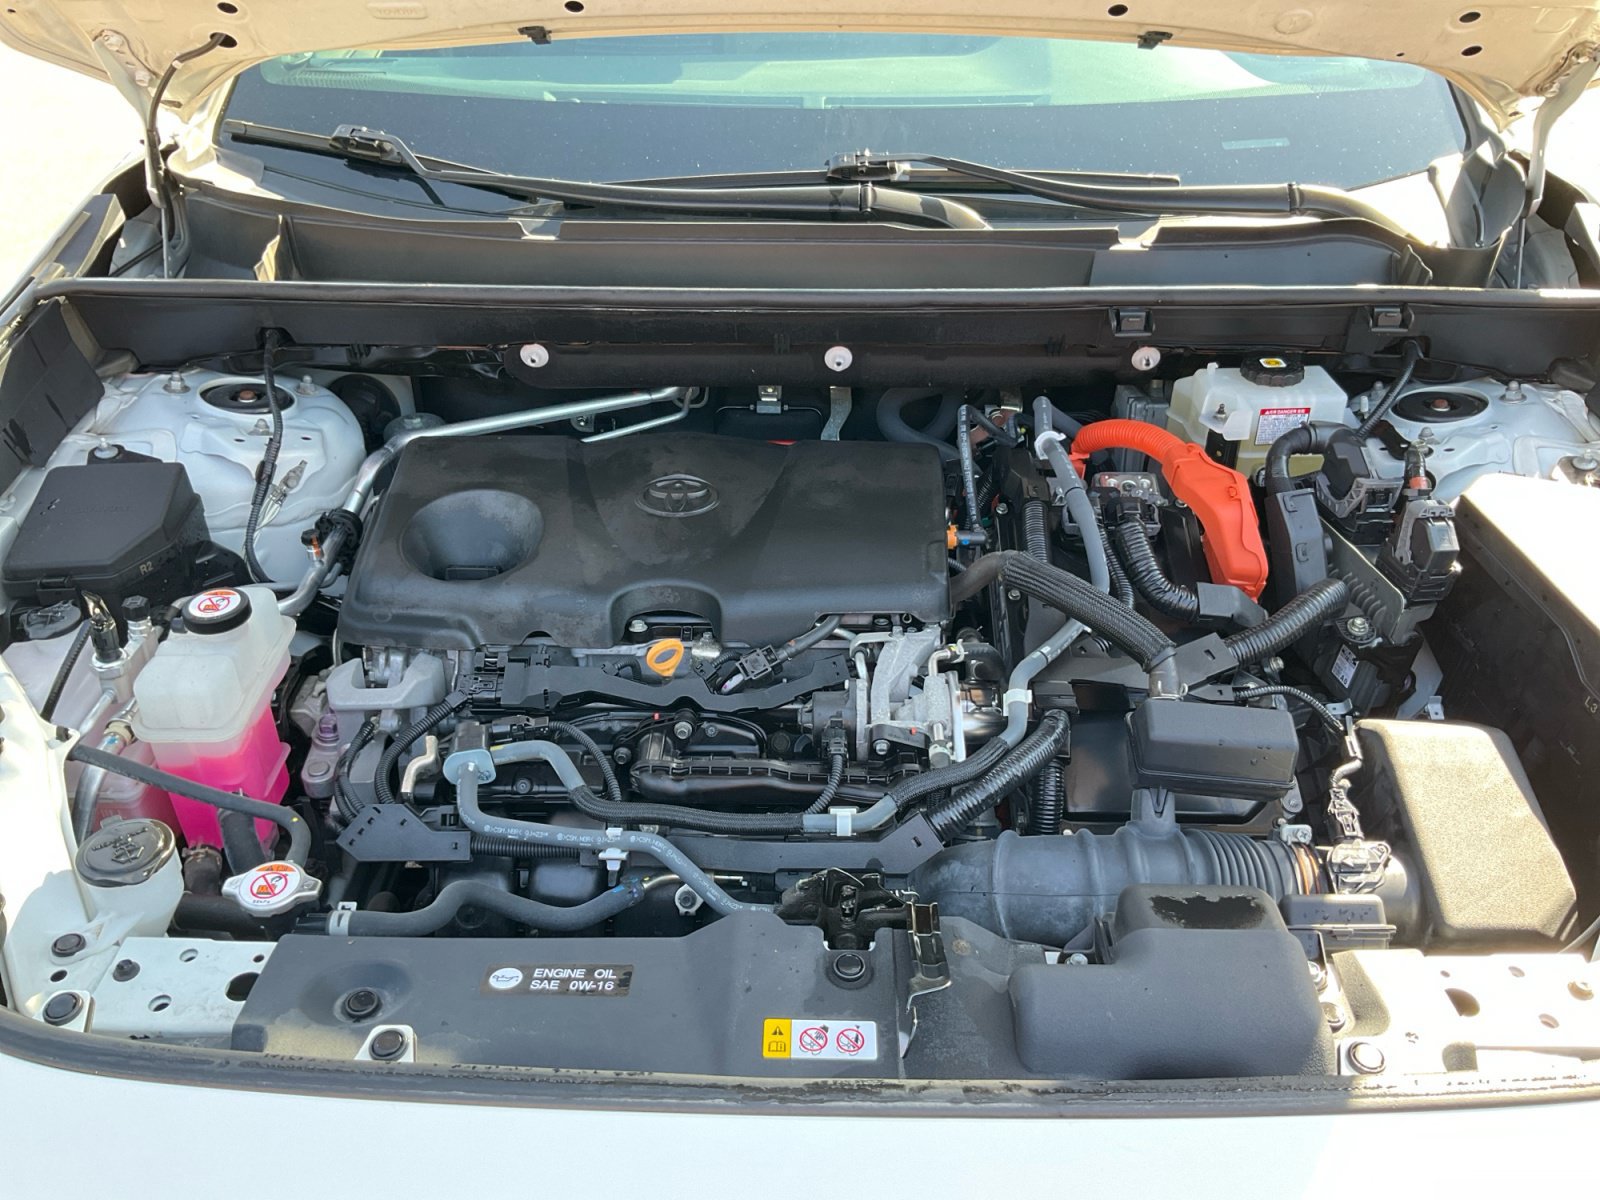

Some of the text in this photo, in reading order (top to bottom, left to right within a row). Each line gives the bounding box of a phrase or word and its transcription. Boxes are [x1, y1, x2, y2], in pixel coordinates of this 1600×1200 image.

[139, 561, 154, 575] R2
[1584, 695, 1598, 713] L3
[533, 968, 617, 979] ENGINE OIL
[530, 980, 615, 991] SAE 0W-16
